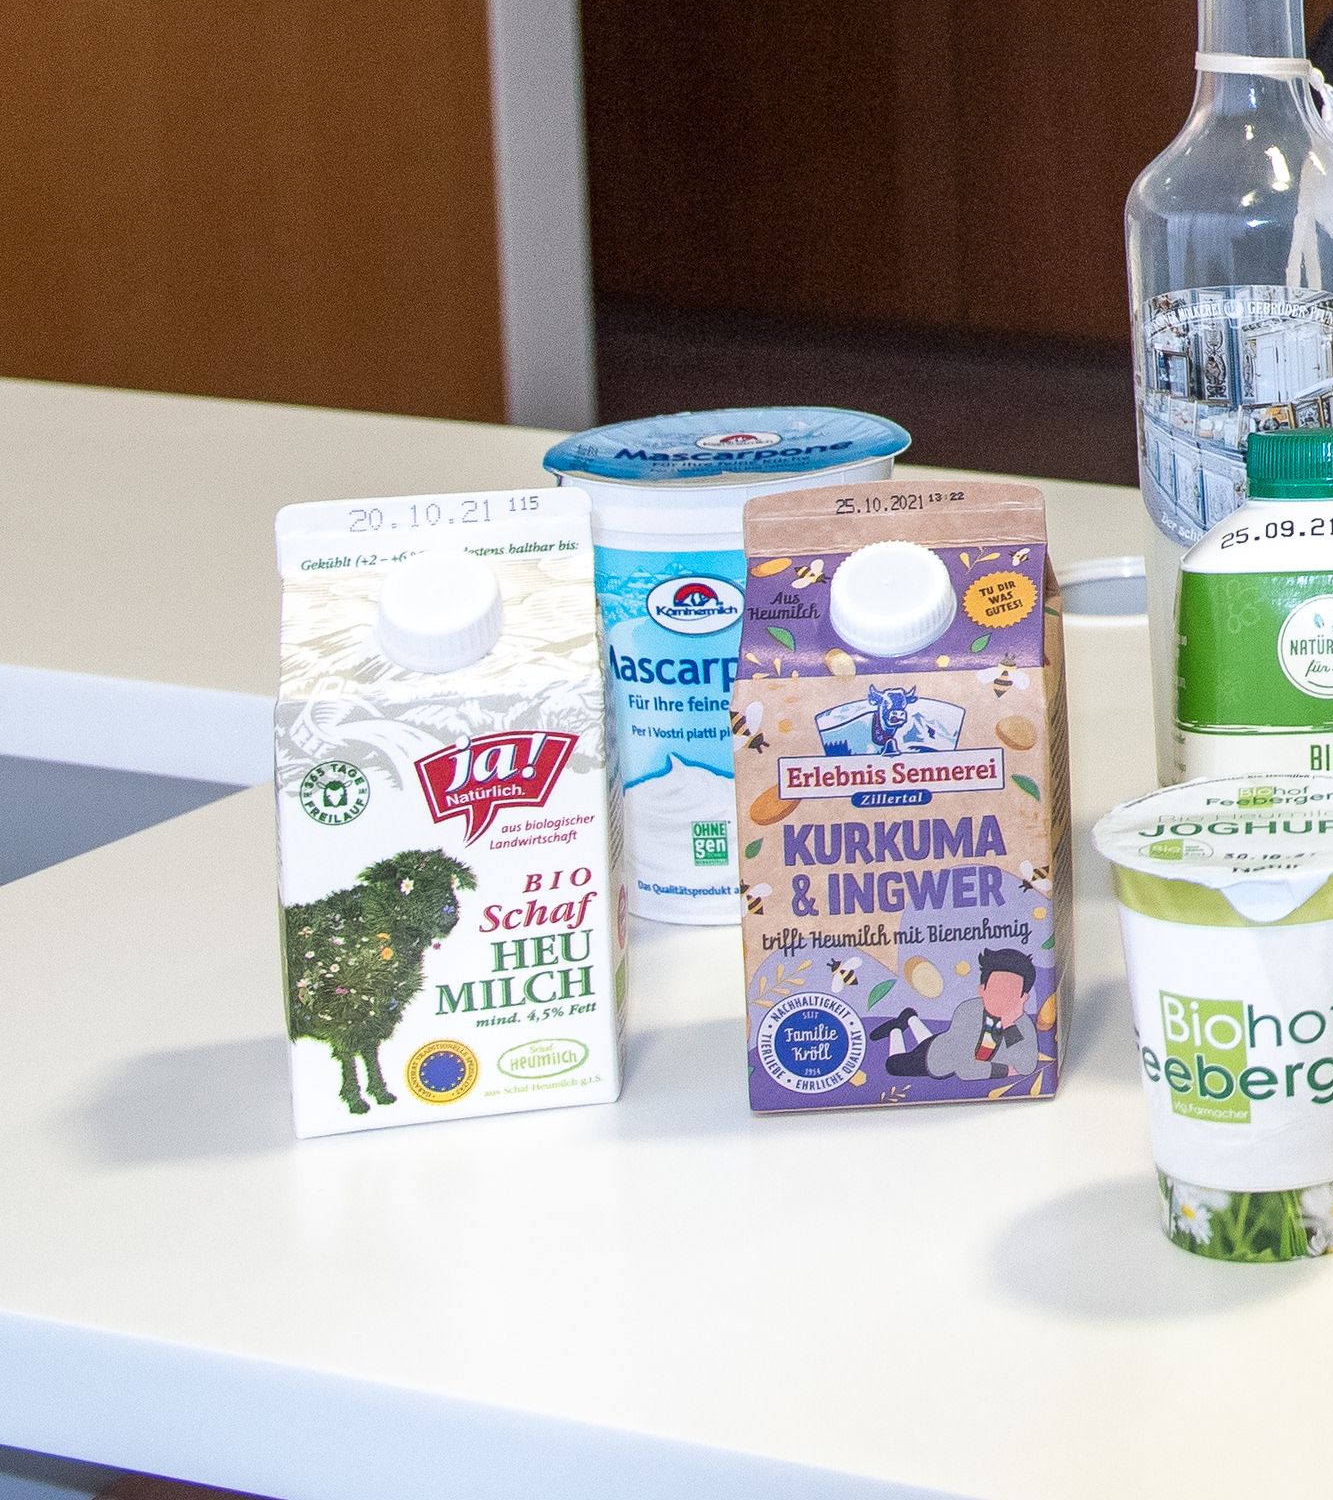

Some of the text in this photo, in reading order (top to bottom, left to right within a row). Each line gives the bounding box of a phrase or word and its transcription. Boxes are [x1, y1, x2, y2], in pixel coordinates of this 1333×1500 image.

[349, 496, 539, 532] 20.10.21 115
[836, 492, 964, 515] 25.10.2021 13:22
[509, 542, 554, 555] haltbar
[558, 541, 579, 552] bis:
[301, 556, 351, 571] Gekühlt
[770, 592, 800, 605] Aus
[979, 580, 1016, 597] TU DIR
[988, 592, 1013, 604] WAS
[750, 603, 820, 621] Heumilch
[985, 600, 1023, 617] GUTES!
[1306, 660, 1328, 677] für
[628, 694, 729, 712] Für Ihre feine
[632, 725, 684, 739] Per Vostri
[445, 732, 547, 793] ja!
[787, 758, 998, 788] Erlebnis Sennerei
[305, 764, 364, 788] 365 TAGE
[446, 783, 526, 806] Natürlich.
[860, 792, 923, 806] Zillertal
[1206, 792, 1333, 807] Feeberger
[1238, 785, 1310, 797] Biohof
[305, 798, 364, 823] FREILAUF
[501, 813, 595, 833] aus biologischer
[692, 822, 727, 836] OHNE
[490, 830, 577, 851] Landwirtschaft
[694, 838, 726, 854] gen
[783, 815, 1007, 866] KURKUMA
[522, 867, 591, 893] BIO
[638, 880, 731, 897] Das Qualitätsprodukt
[791, 866, 1006, 916] & INGWER
[479, 891, 598, 933] Schaf
[762, 918, 1032, 957] trifft Heumilch mit Bienenhonig
[491, 929, 593, 972] HEU
[435, 966, 596, 1016] MILCH
[476, 1002, 596, 1028] mind. 4,5% Fett
[771, 996, 851, 1022] NACHHALTIGKEIT
[784, 1023, 838, 1042] Familie
[510, 1050, 577, 1071] Heumilch
[761, 1034, 786, 1079] TIERLIEBE
[791, 1043, 832, 1060] Kröll
[796, 1030, 862, 1090] EHRLICHE QUALITÄT
